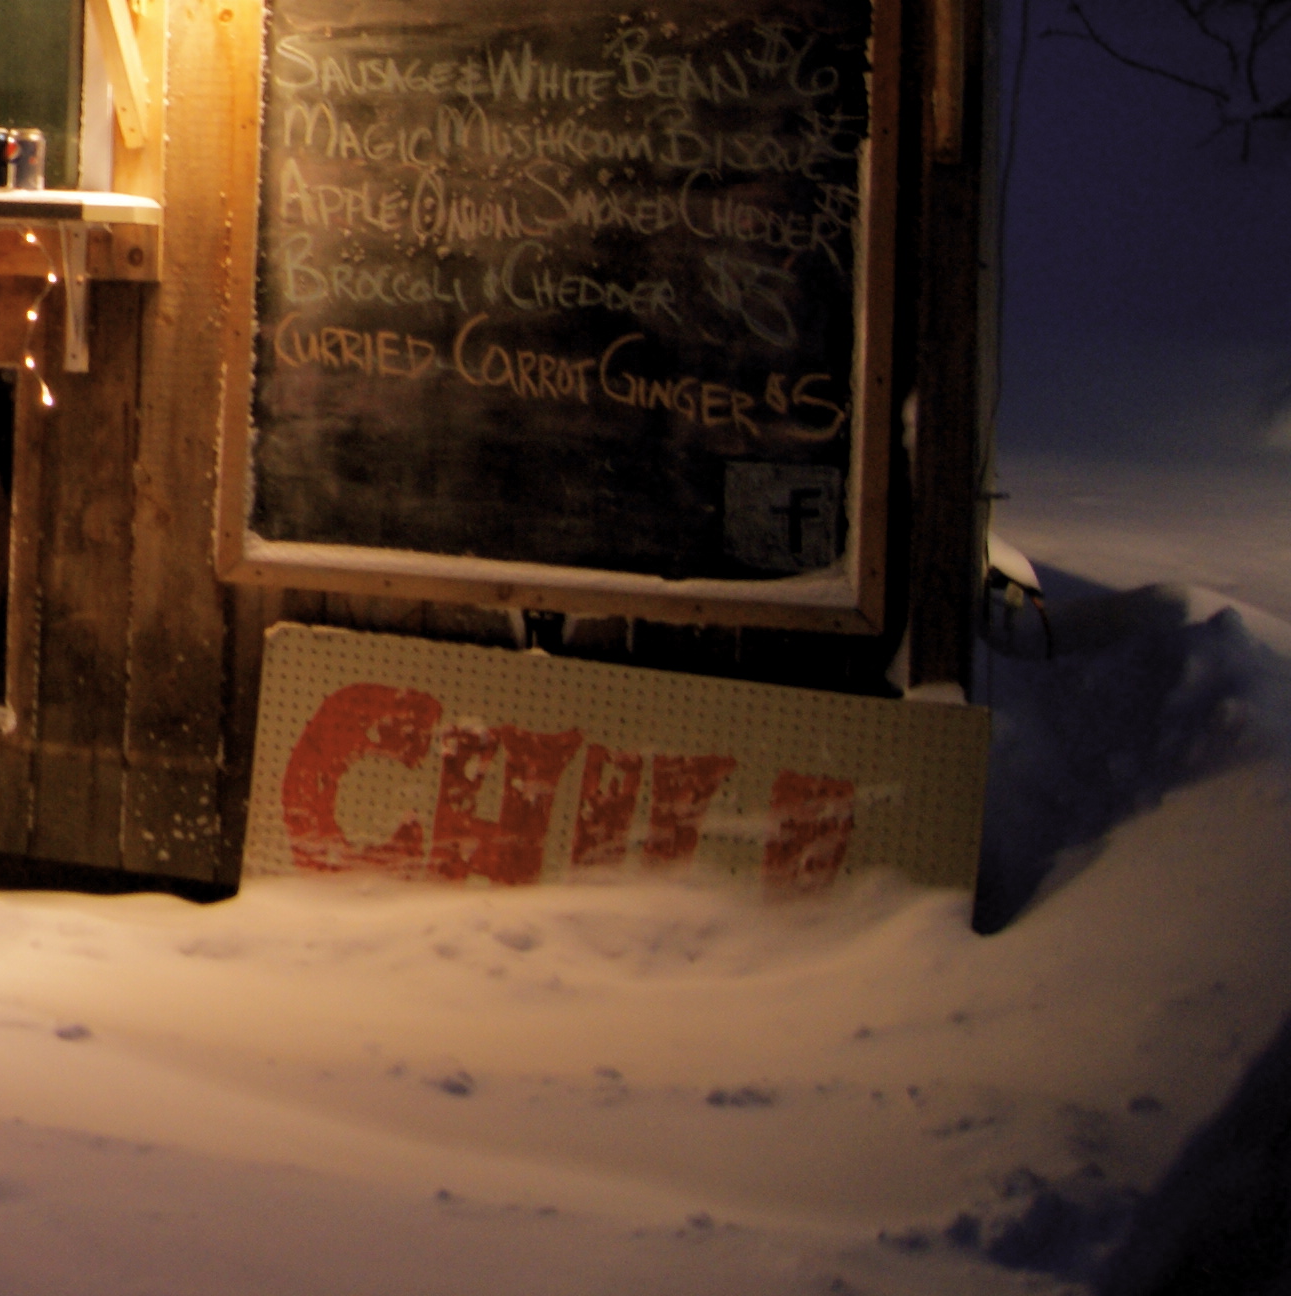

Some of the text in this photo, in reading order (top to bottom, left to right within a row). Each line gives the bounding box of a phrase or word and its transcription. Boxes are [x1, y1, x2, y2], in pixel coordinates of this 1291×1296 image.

[274, 35, 456, 96] SAUSAGE
[485, 42, 616, 101] WHITE
[602, 26, 749, 103] BEAN
[282, 98, 433, 166] MAGIC
[437, 103, 654, 161] MUSHROOM
[277, 158, 404, 232] APPLE
[519, 157, 677, 235] SMOKED
[281, 231, 470, 312] BROCCOLI
[274, 310, 435, 377] CURRIED
[453, 313, 596, 401] CARROT
[599, 331, 761, 437] GINGER
